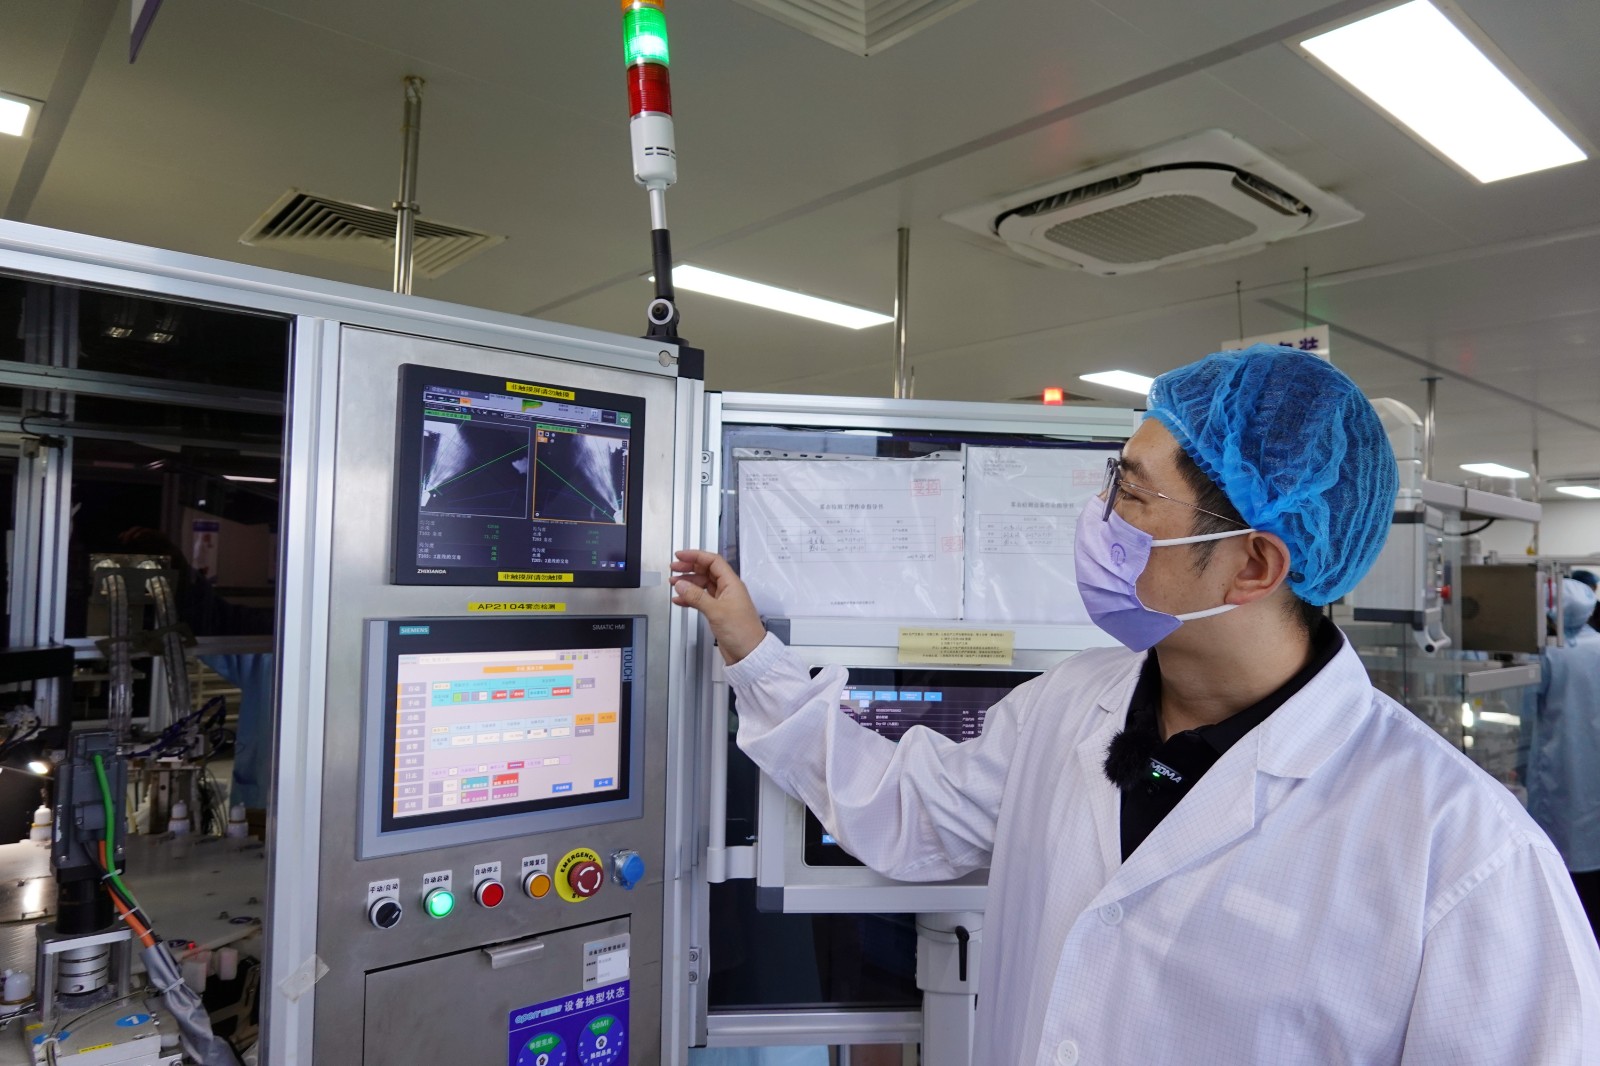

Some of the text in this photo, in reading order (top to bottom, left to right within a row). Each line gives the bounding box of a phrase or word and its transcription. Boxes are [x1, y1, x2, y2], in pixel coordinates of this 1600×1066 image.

[511, 384, 570, 399] 非触摸屏请勿触摸
[620, 416, 629, 424] OK
[504, 573, 563, 582] 非触摸屏请勿触摸
[624, 650, 632, 682] TOUCH
[524, 858, 546, 867] 故障复位
[560, 852, 597, 873] EMERGENCY
[475, 866, 498, 875] 自动停止
[424, 875, 450, 885] 自动启动
[369, 883, 399, 893] 手动/自动
[564, 986, 625, 1012] 设备换型状态
[530, 1036, 553, 1050] 换型完成
